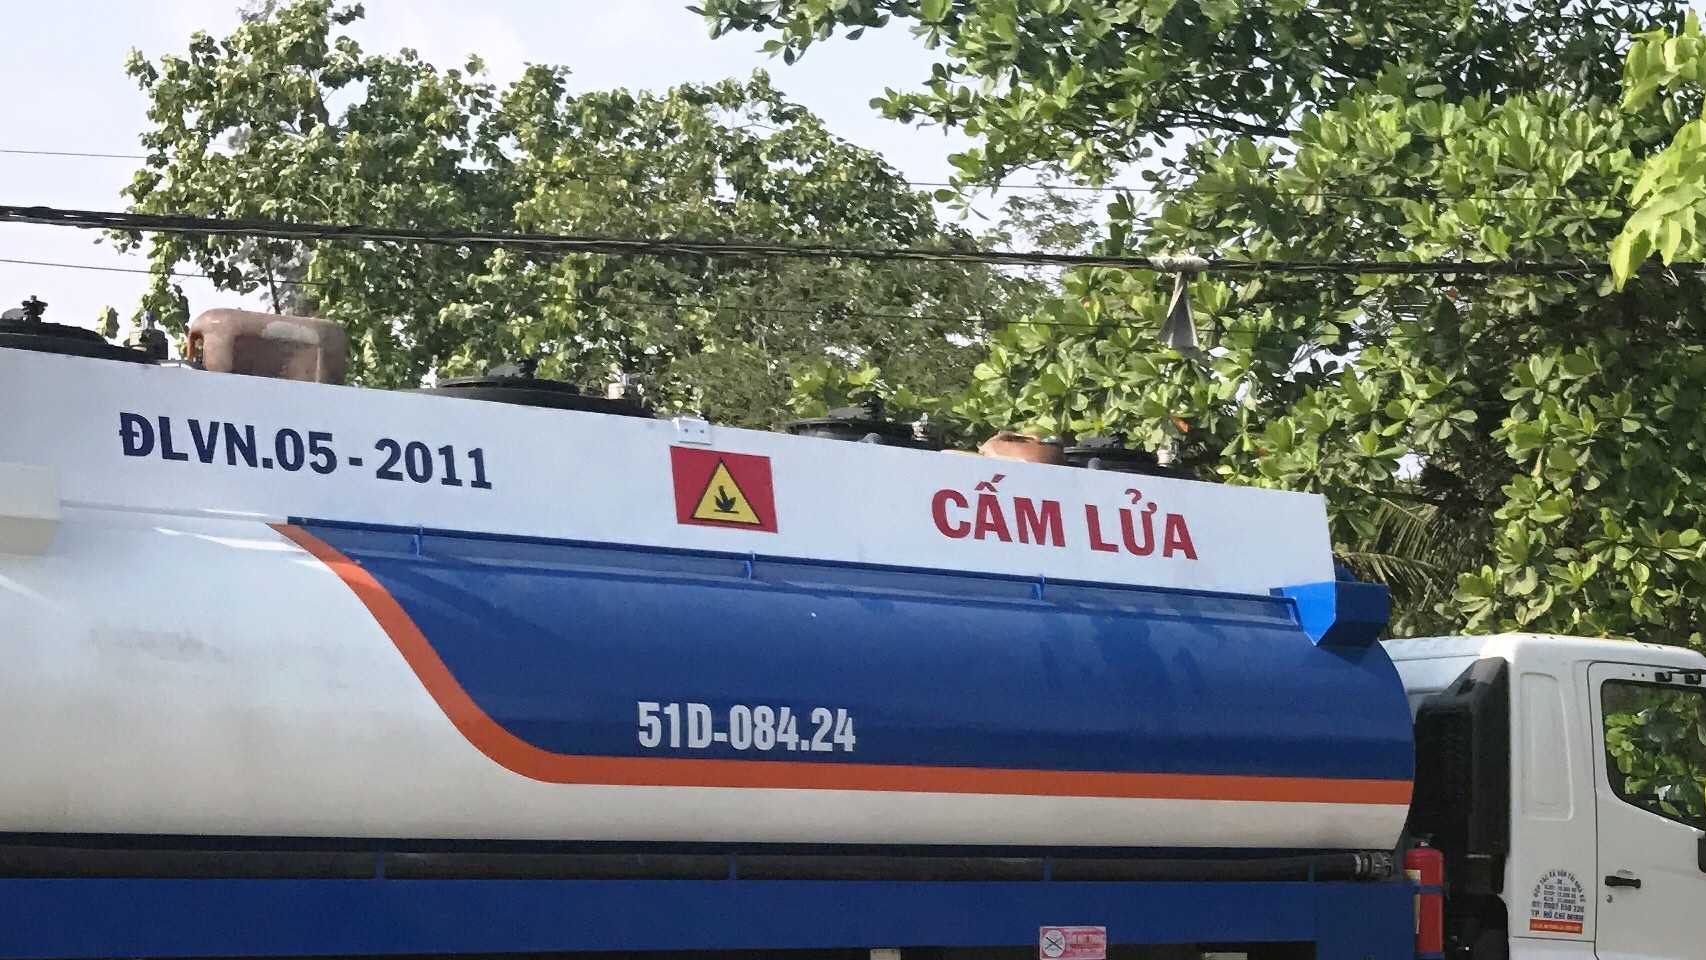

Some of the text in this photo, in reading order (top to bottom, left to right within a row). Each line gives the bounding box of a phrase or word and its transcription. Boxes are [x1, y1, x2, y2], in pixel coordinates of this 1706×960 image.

[119, 412, 338, 475] ĐLVN.05
[374, 438, 493, 490] 2011
[931, 474, 1199, 560] CẤM LỬA
[637, 701, 856, 752] 51D-084.24
